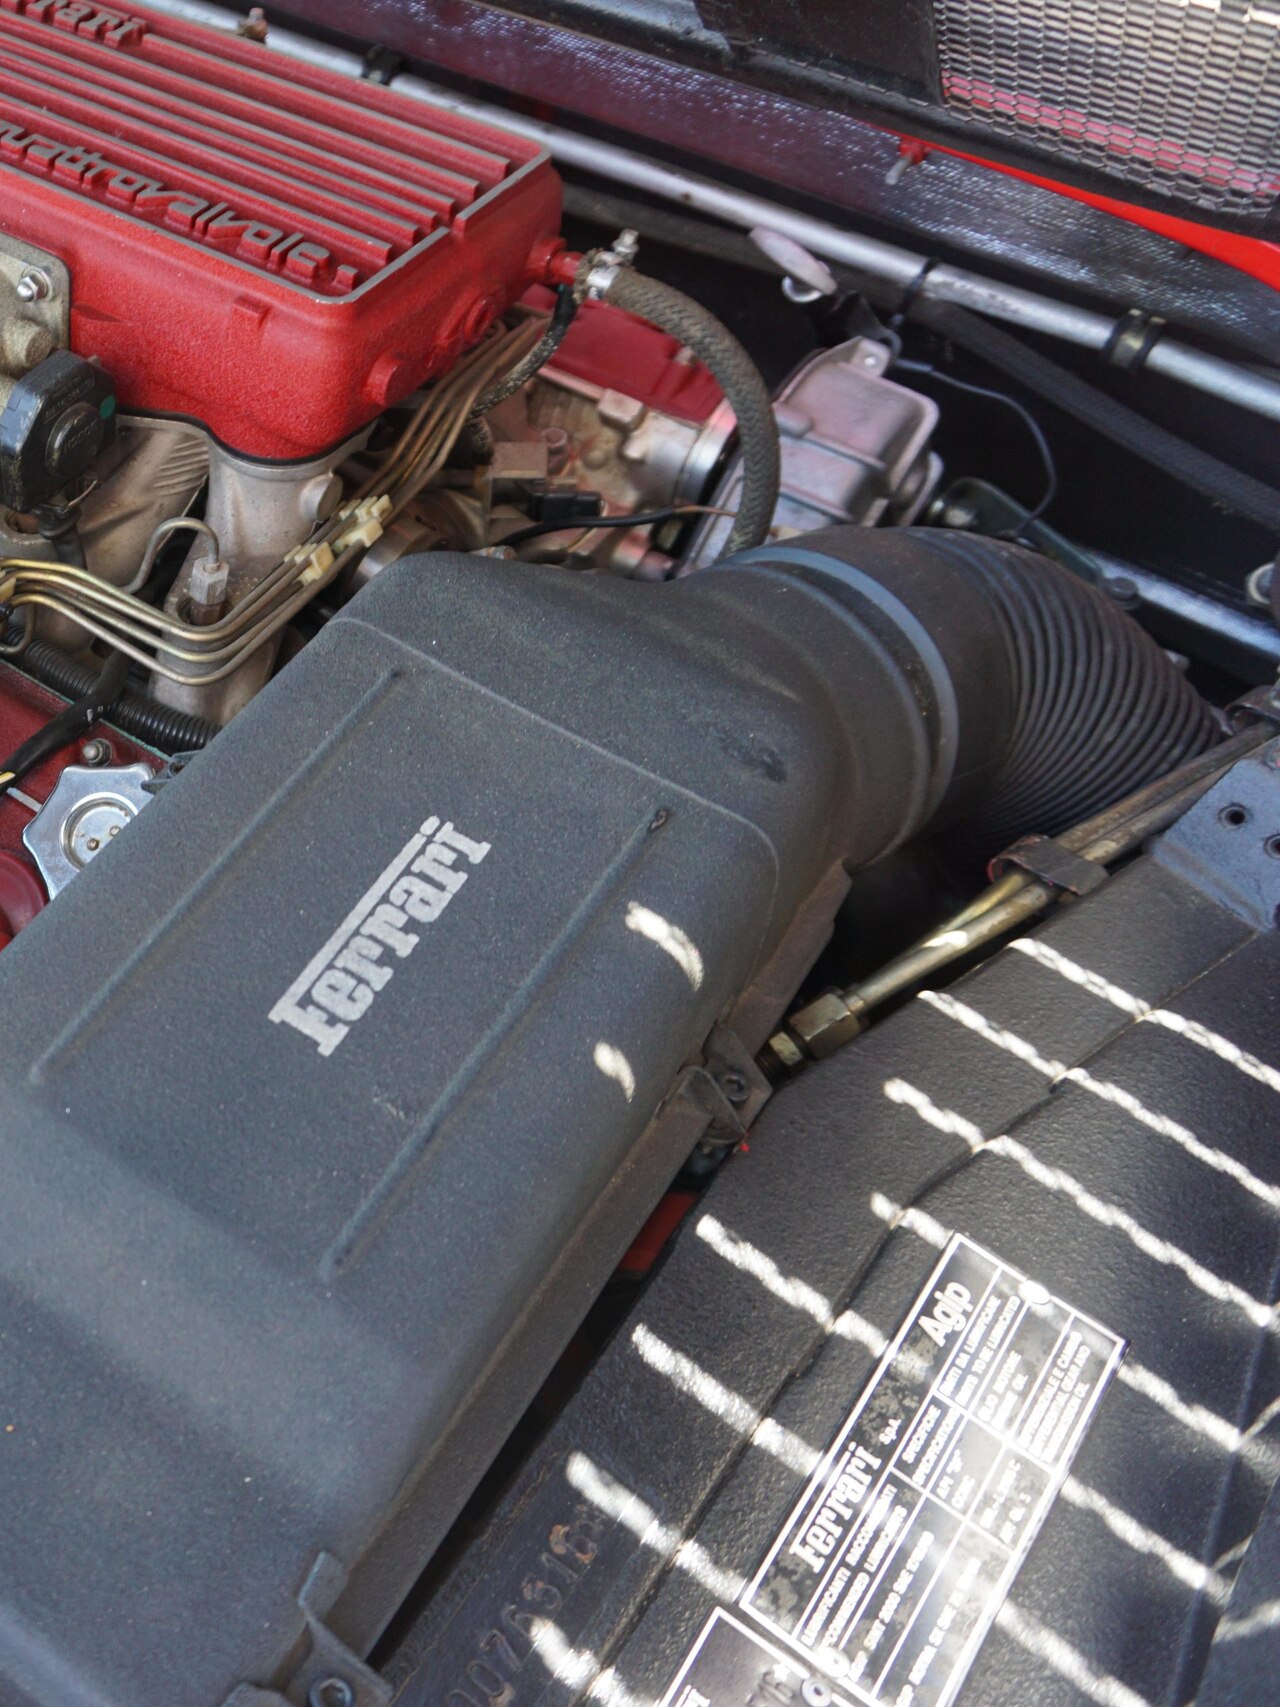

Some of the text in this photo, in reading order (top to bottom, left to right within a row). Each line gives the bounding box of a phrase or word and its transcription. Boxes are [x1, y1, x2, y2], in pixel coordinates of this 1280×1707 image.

[0, 0, 147, 48] rari
[268, 815, 492, 1057] Ferrari
[972, 1359, 986, 1374] TO
[790, 1442, 882, 1571] Ferrari
[918, 1281, 972, 1349] Agip
[901, 1405, 940, 1463] SPECIFICHE
[912, 1407, 960, 1484] SPECIFICATIONS
[801, 1567, 850, 1645] LUBRIFICANTI
